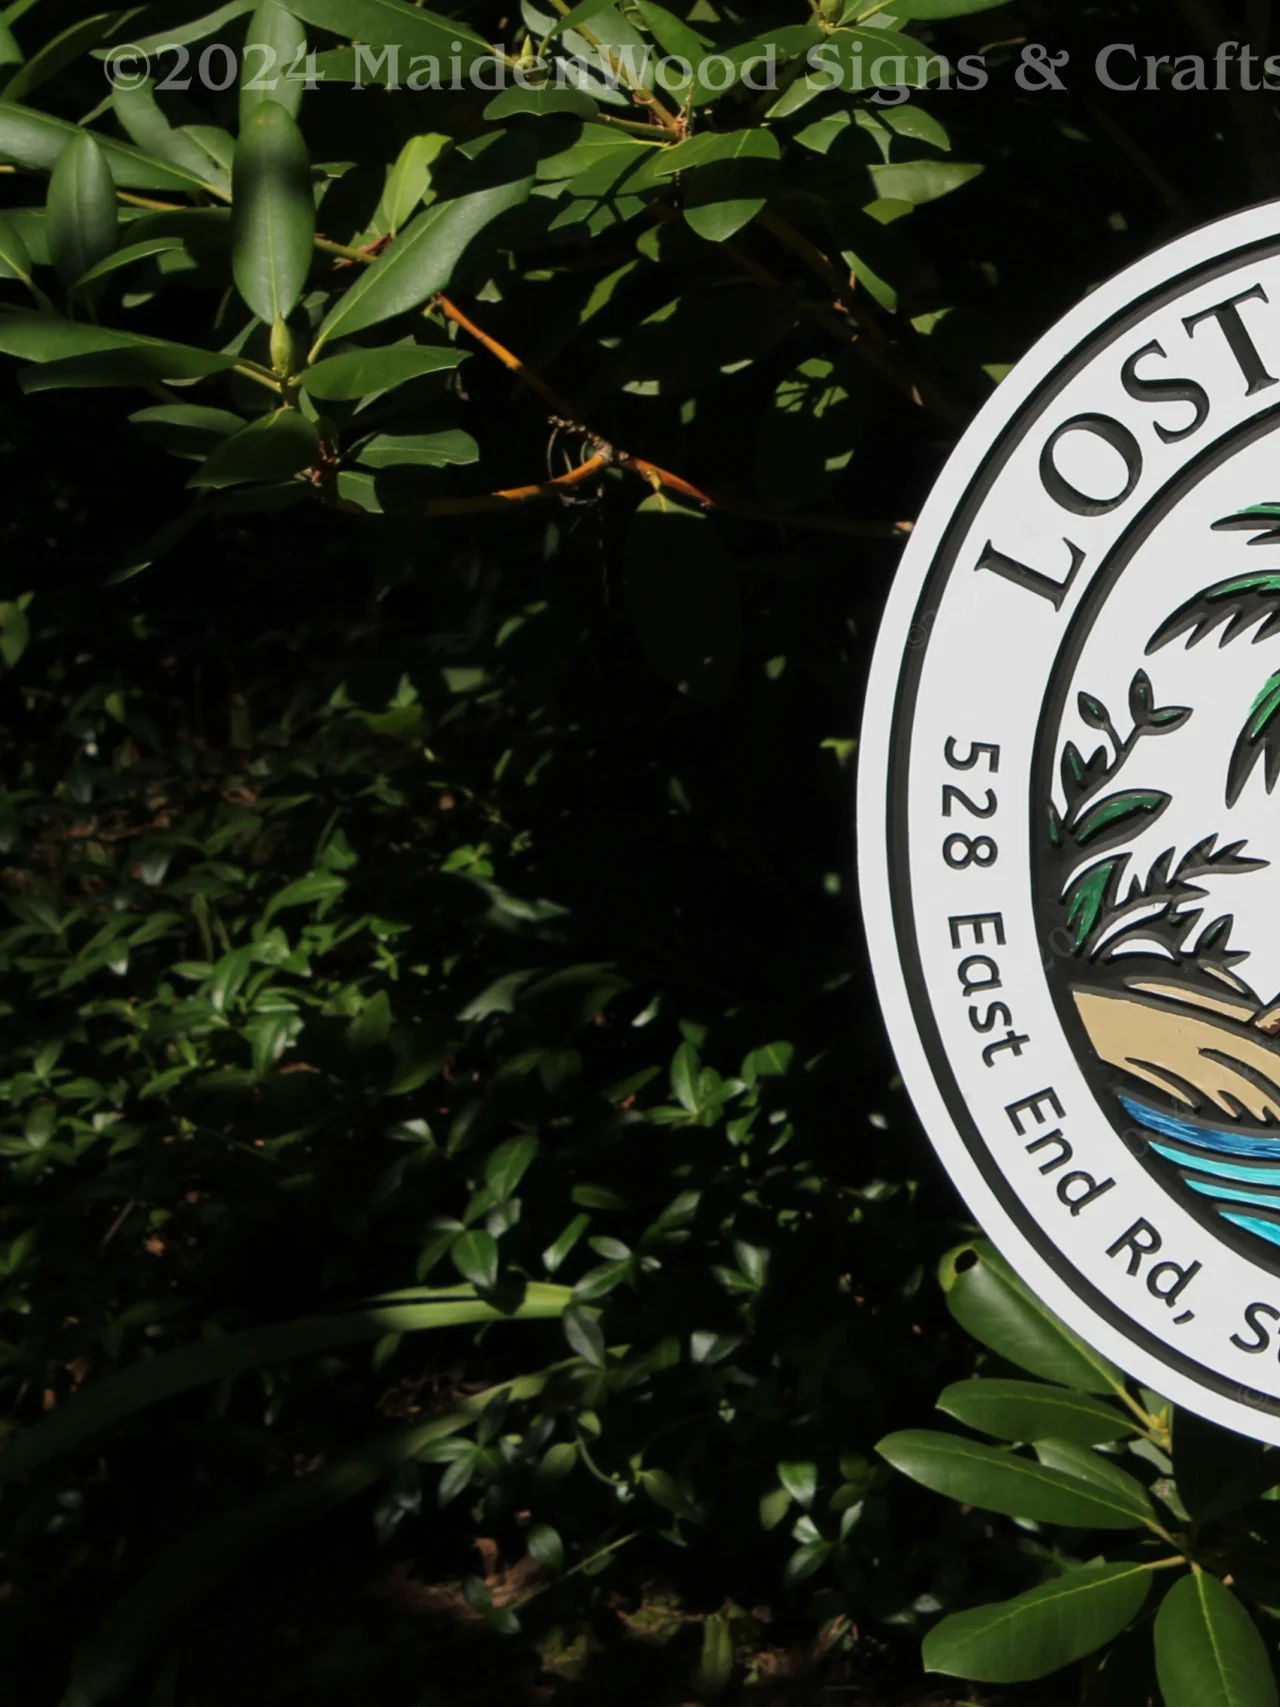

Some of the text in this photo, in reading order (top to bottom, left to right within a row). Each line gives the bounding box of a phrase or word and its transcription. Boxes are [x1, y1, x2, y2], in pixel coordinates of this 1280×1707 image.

[974, 283, 1280, 613] LOST
[942, 736, 1001, 870] 528
[947, 911, 1031, 1068] East
[1004, 1087, 1117, 1217] End
[1106, 1217, 1204, 1326] Rd,
